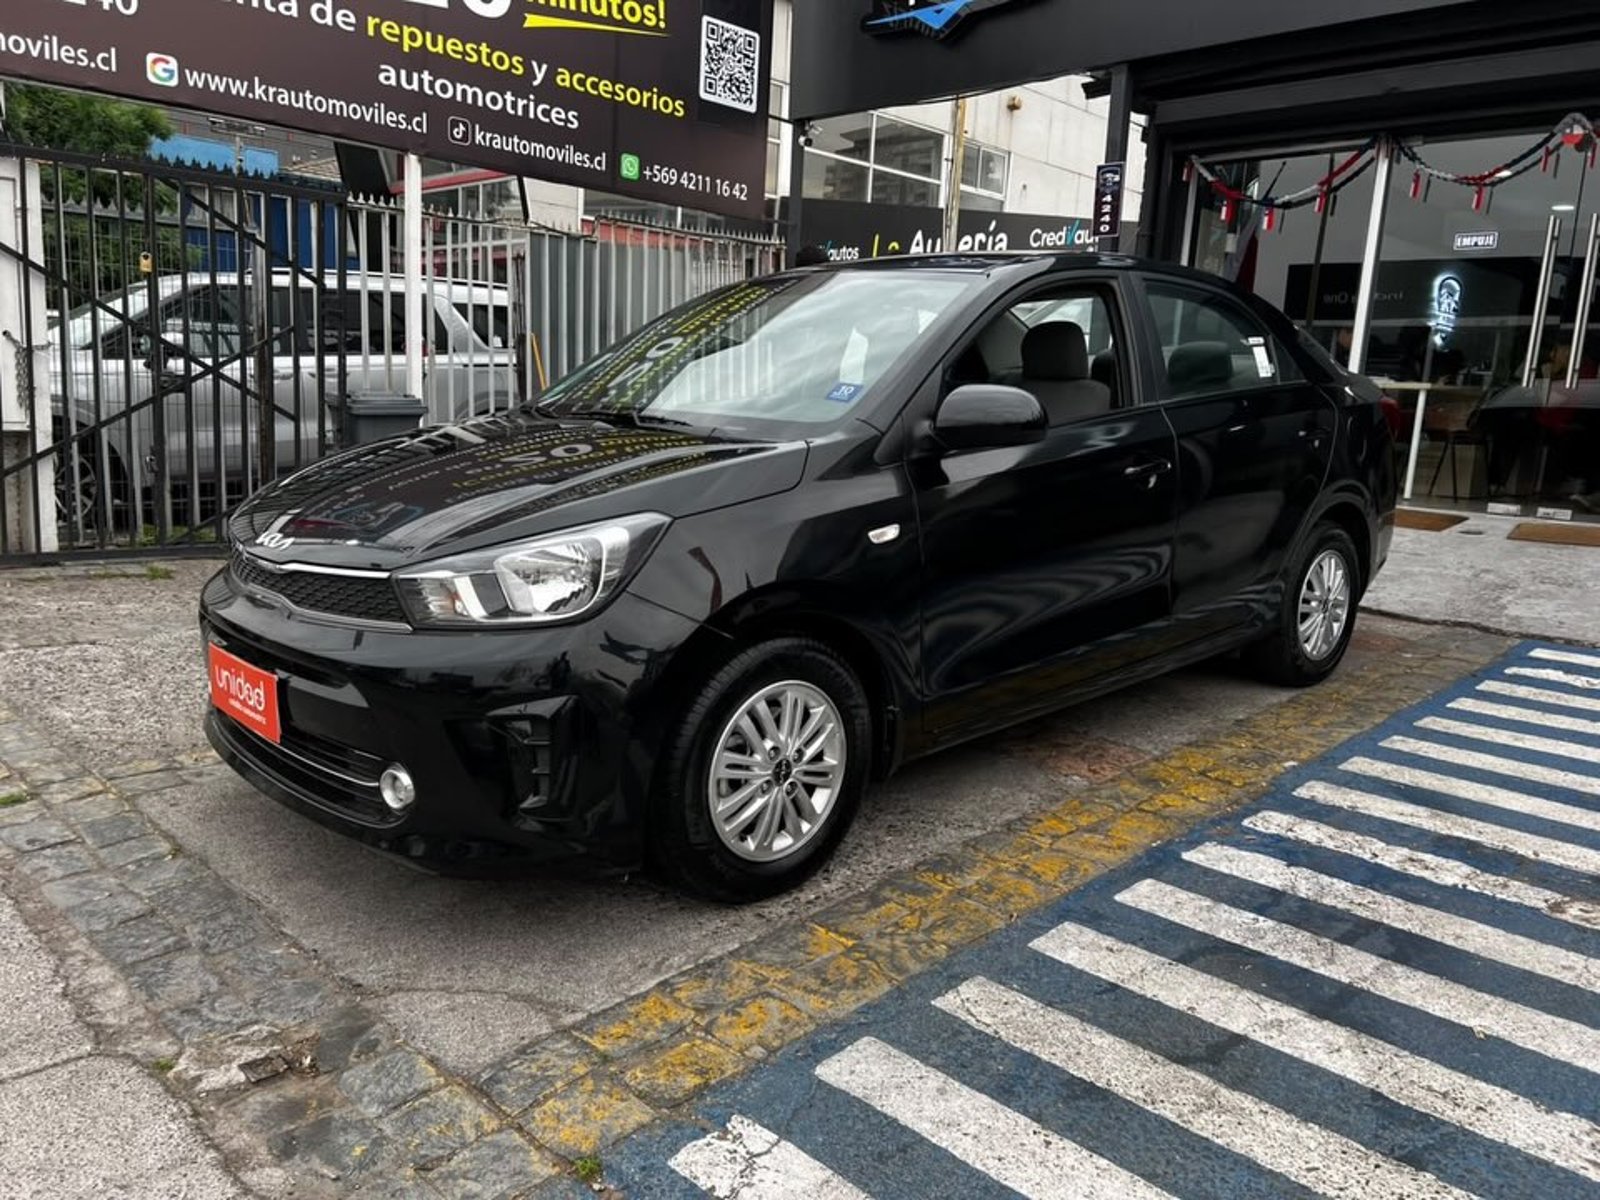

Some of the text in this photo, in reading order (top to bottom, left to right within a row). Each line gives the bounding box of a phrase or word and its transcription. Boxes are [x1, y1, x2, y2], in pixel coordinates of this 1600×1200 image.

[309, 0, 356, 31] de
[366, 15, 525, 76] repuestos
[531, 60, 548, 86] y
[555, 66, 686, 118] accesorios
[184, 67, 428, 134] www.krautomoviles.cl
[378, 63, 580, 129] automotrices
[474, 123, 606, 171] krautomoviles.cl
[643, 164, 678, 186] +569
[680, 171, 711, 193] 4211
[214, 664, 266, 711] unidad
